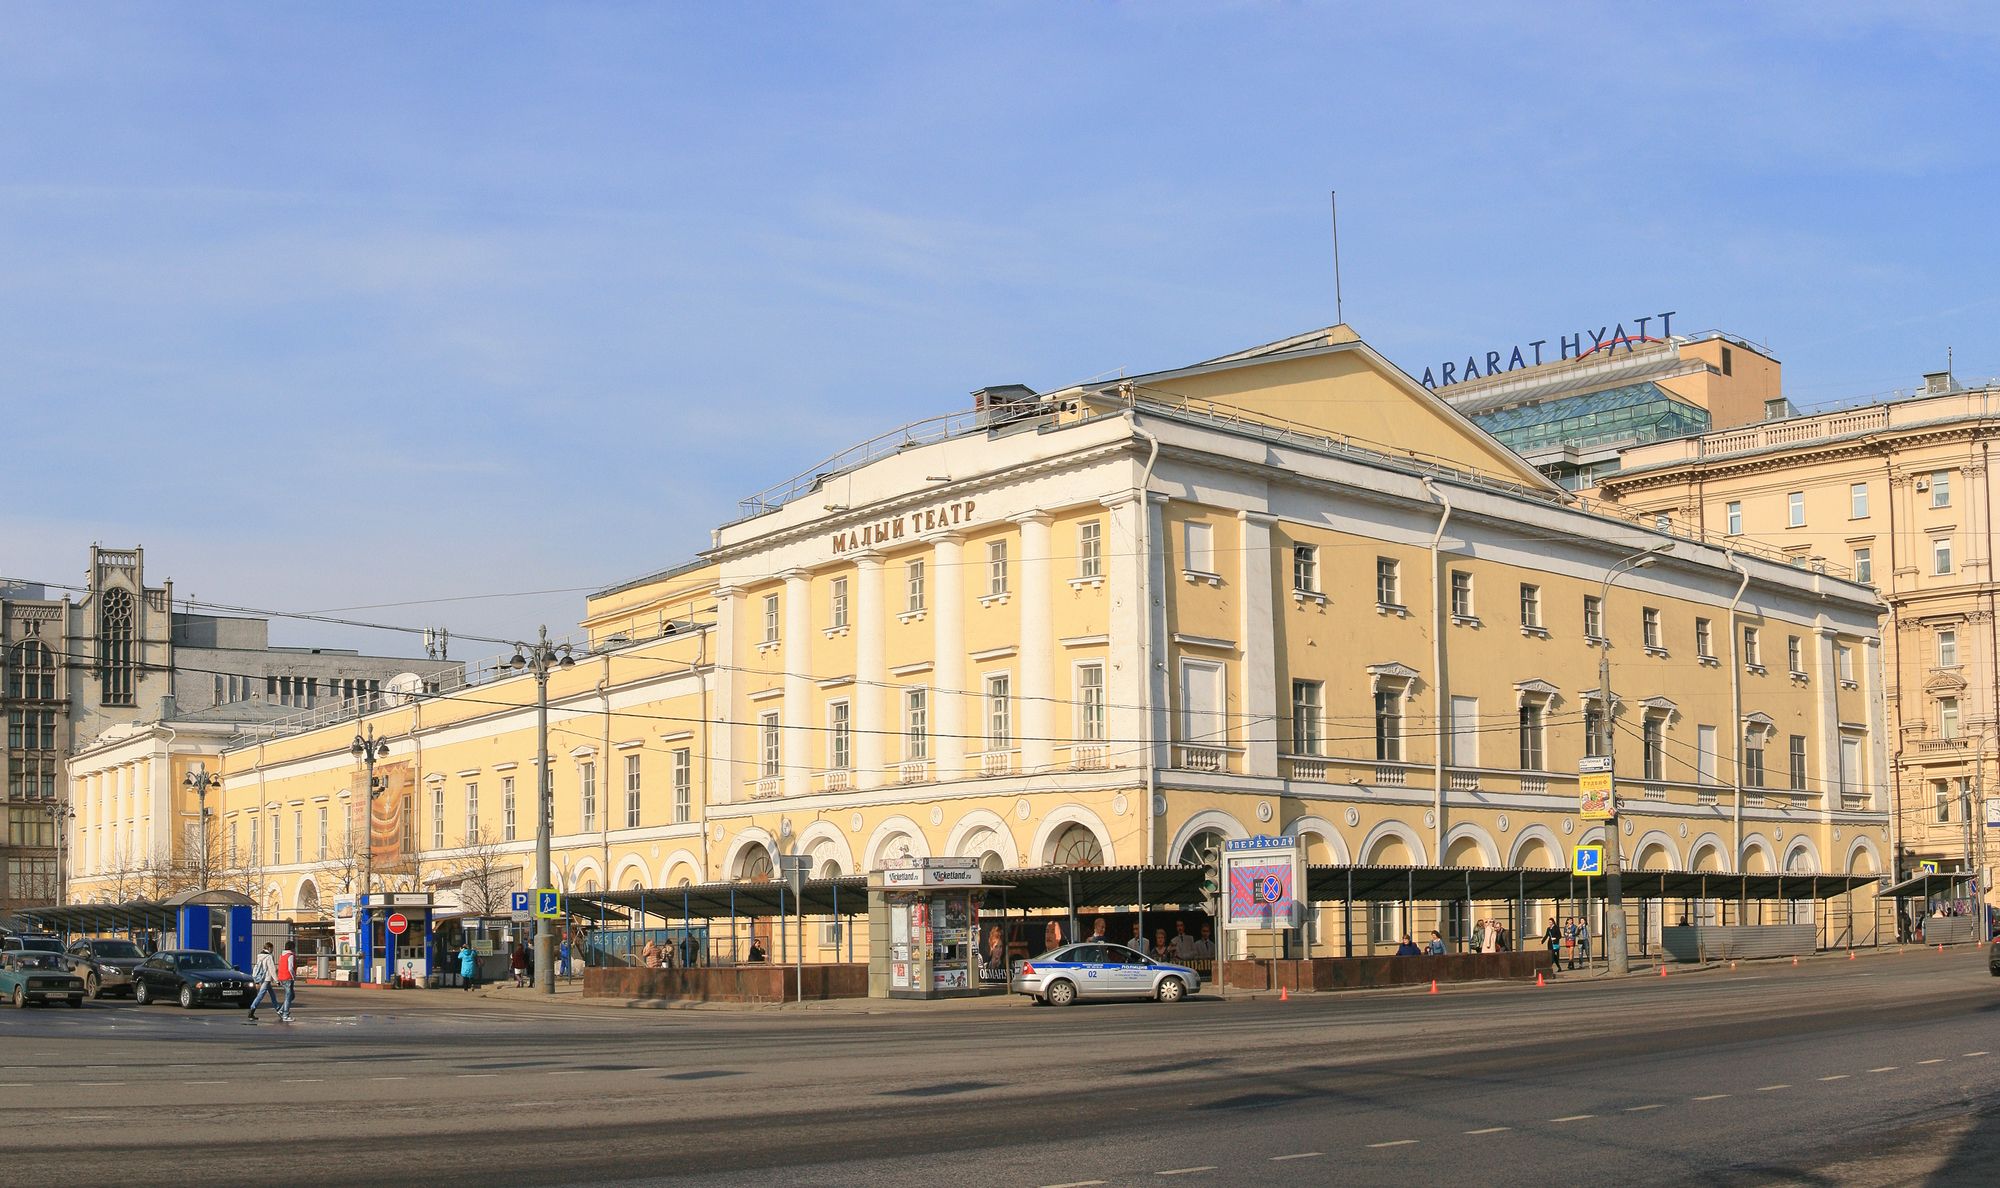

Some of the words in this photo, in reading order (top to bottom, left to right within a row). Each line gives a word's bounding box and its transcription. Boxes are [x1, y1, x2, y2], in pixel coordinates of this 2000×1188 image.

[1421, 340, 1546, 389] ARARAT
[1561, 311, 1676, 361] HYATT
[832, 515, 905, 554] МАЛЫЙ
[912, 500, 976, 533] ТЕАТР
[1234, 838, 1287, 849] ПЕРЕХОД
[933, 870, 972, 882] Ticketland.ru
[516, 894, 527, 910] P
[1088, 970, 1097, 978] 02
